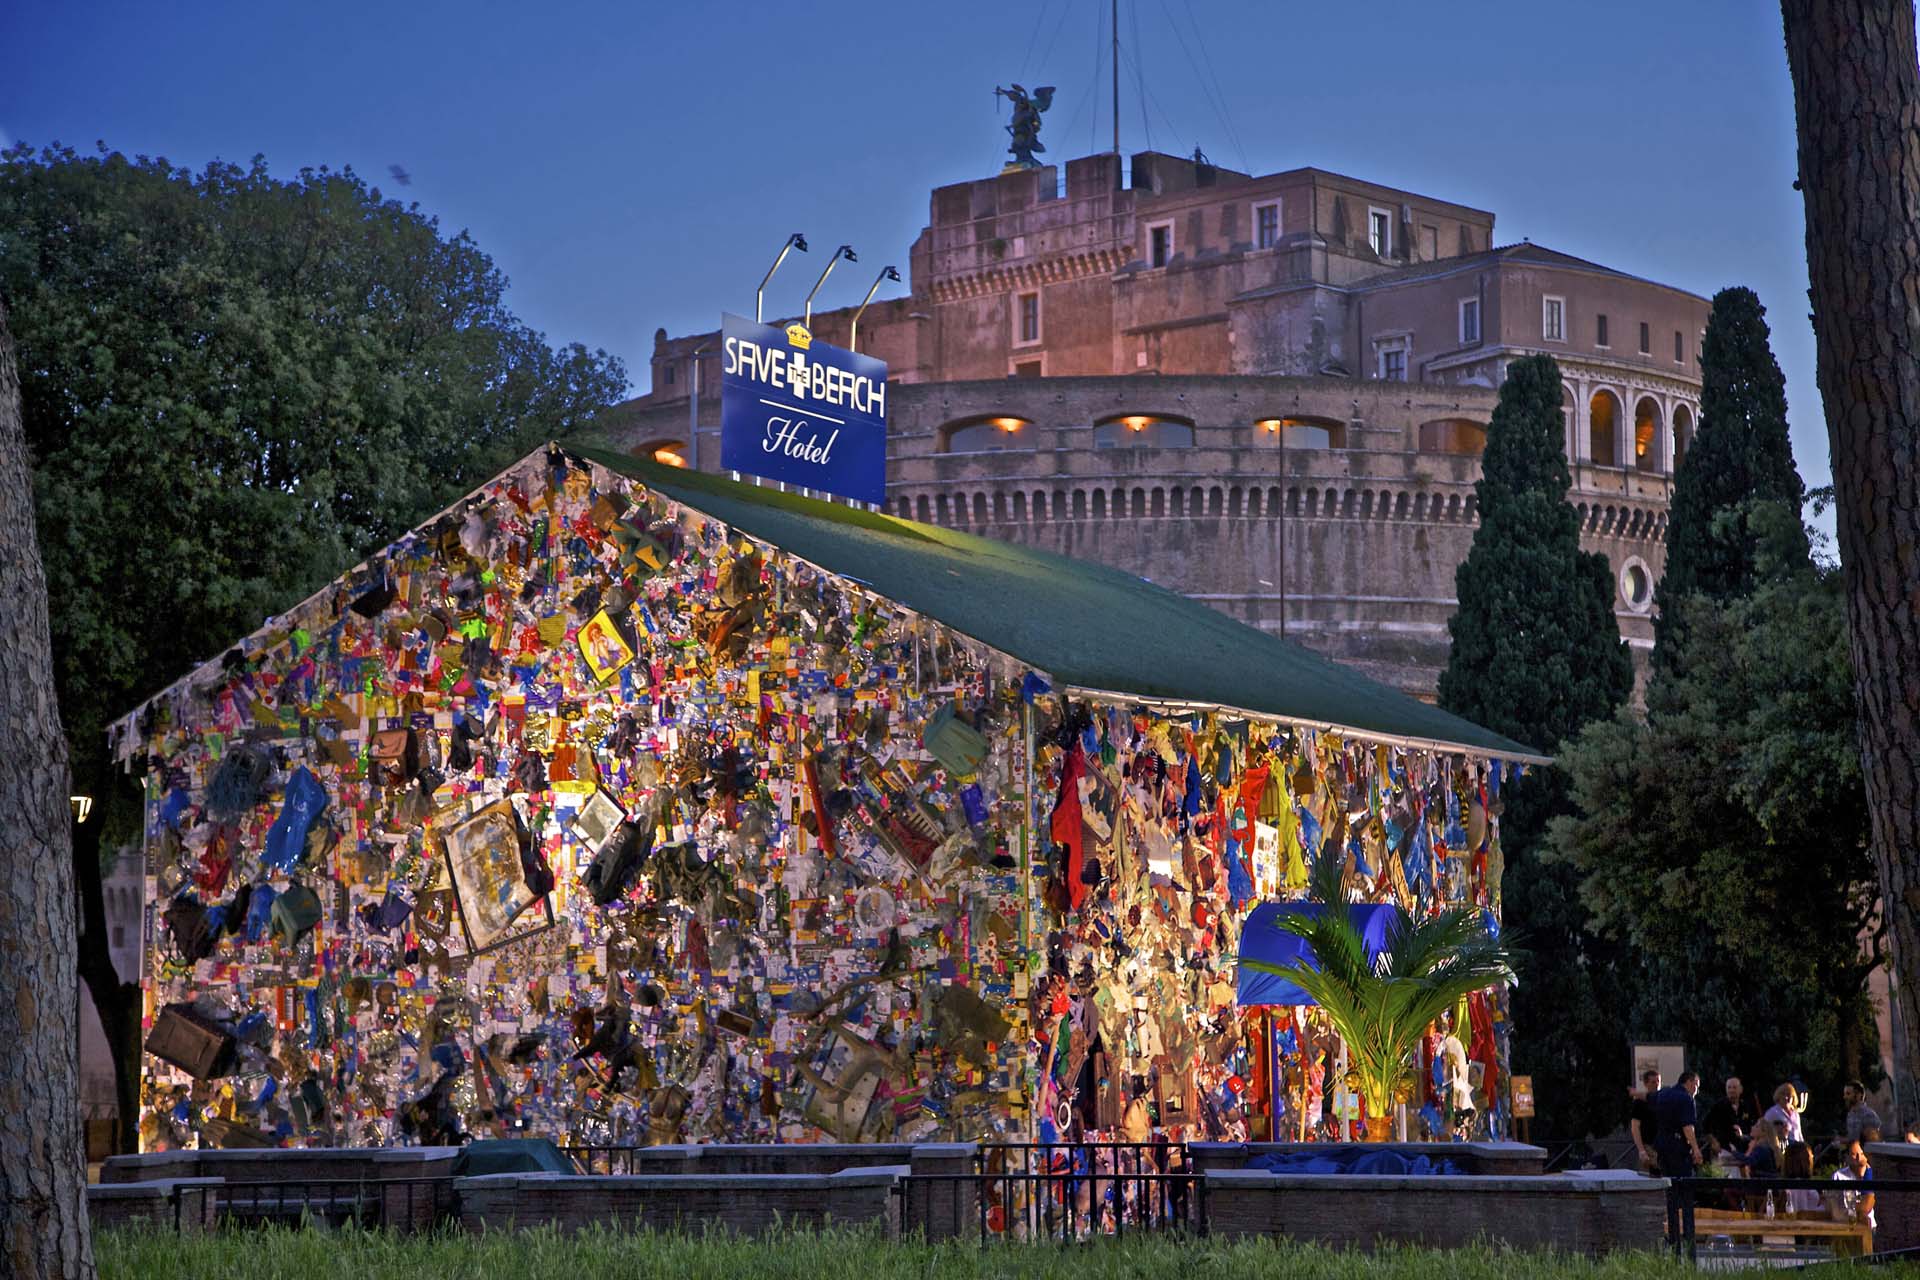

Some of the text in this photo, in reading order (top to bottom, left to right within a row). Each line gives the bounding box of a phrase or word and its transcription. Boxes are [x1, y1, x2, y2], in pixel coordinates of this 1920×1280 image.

[725, 337, 885, 418] SAVE THE BEACH
[762, 416, 839, 465] Hotel
